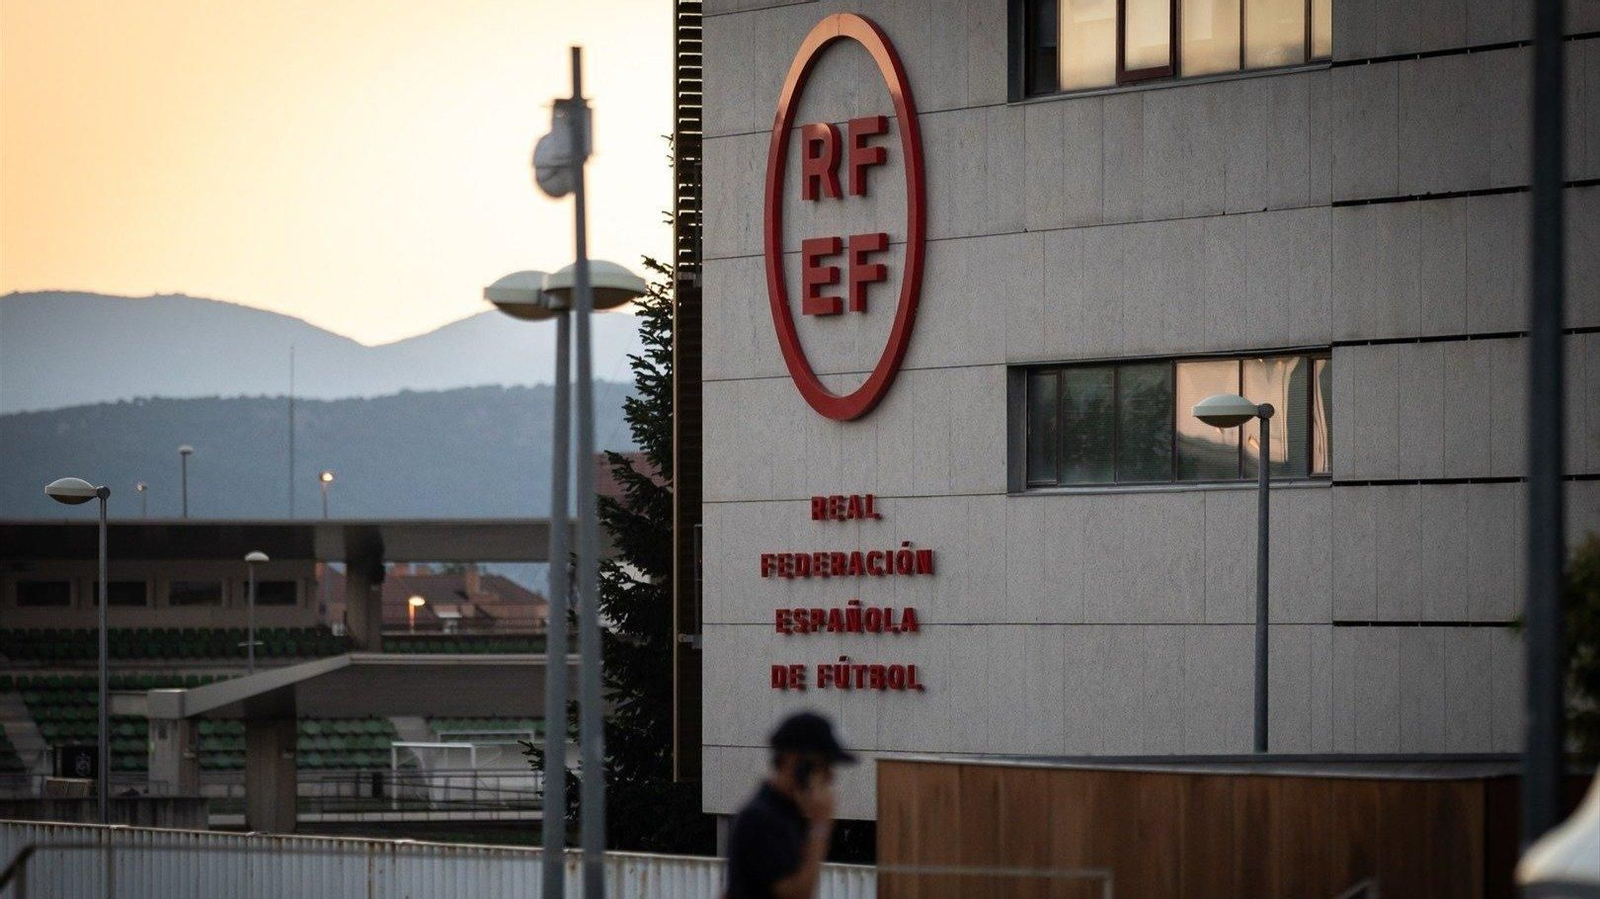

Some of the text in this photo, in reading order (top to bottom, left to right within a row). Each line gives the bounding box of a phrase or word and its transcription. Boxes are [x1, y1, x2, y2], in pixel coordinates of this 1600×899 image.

[802, 115, 889, 201] RF
[802, 233, 889, 315] EF
[811, 494, 881, 521] REAL
[761, 541, 935, 578] FEDERACIÓN
[775, 600, 919, 634] ESPAÑOLA
[771, 656, 924, 691] DE FÚTBOL
